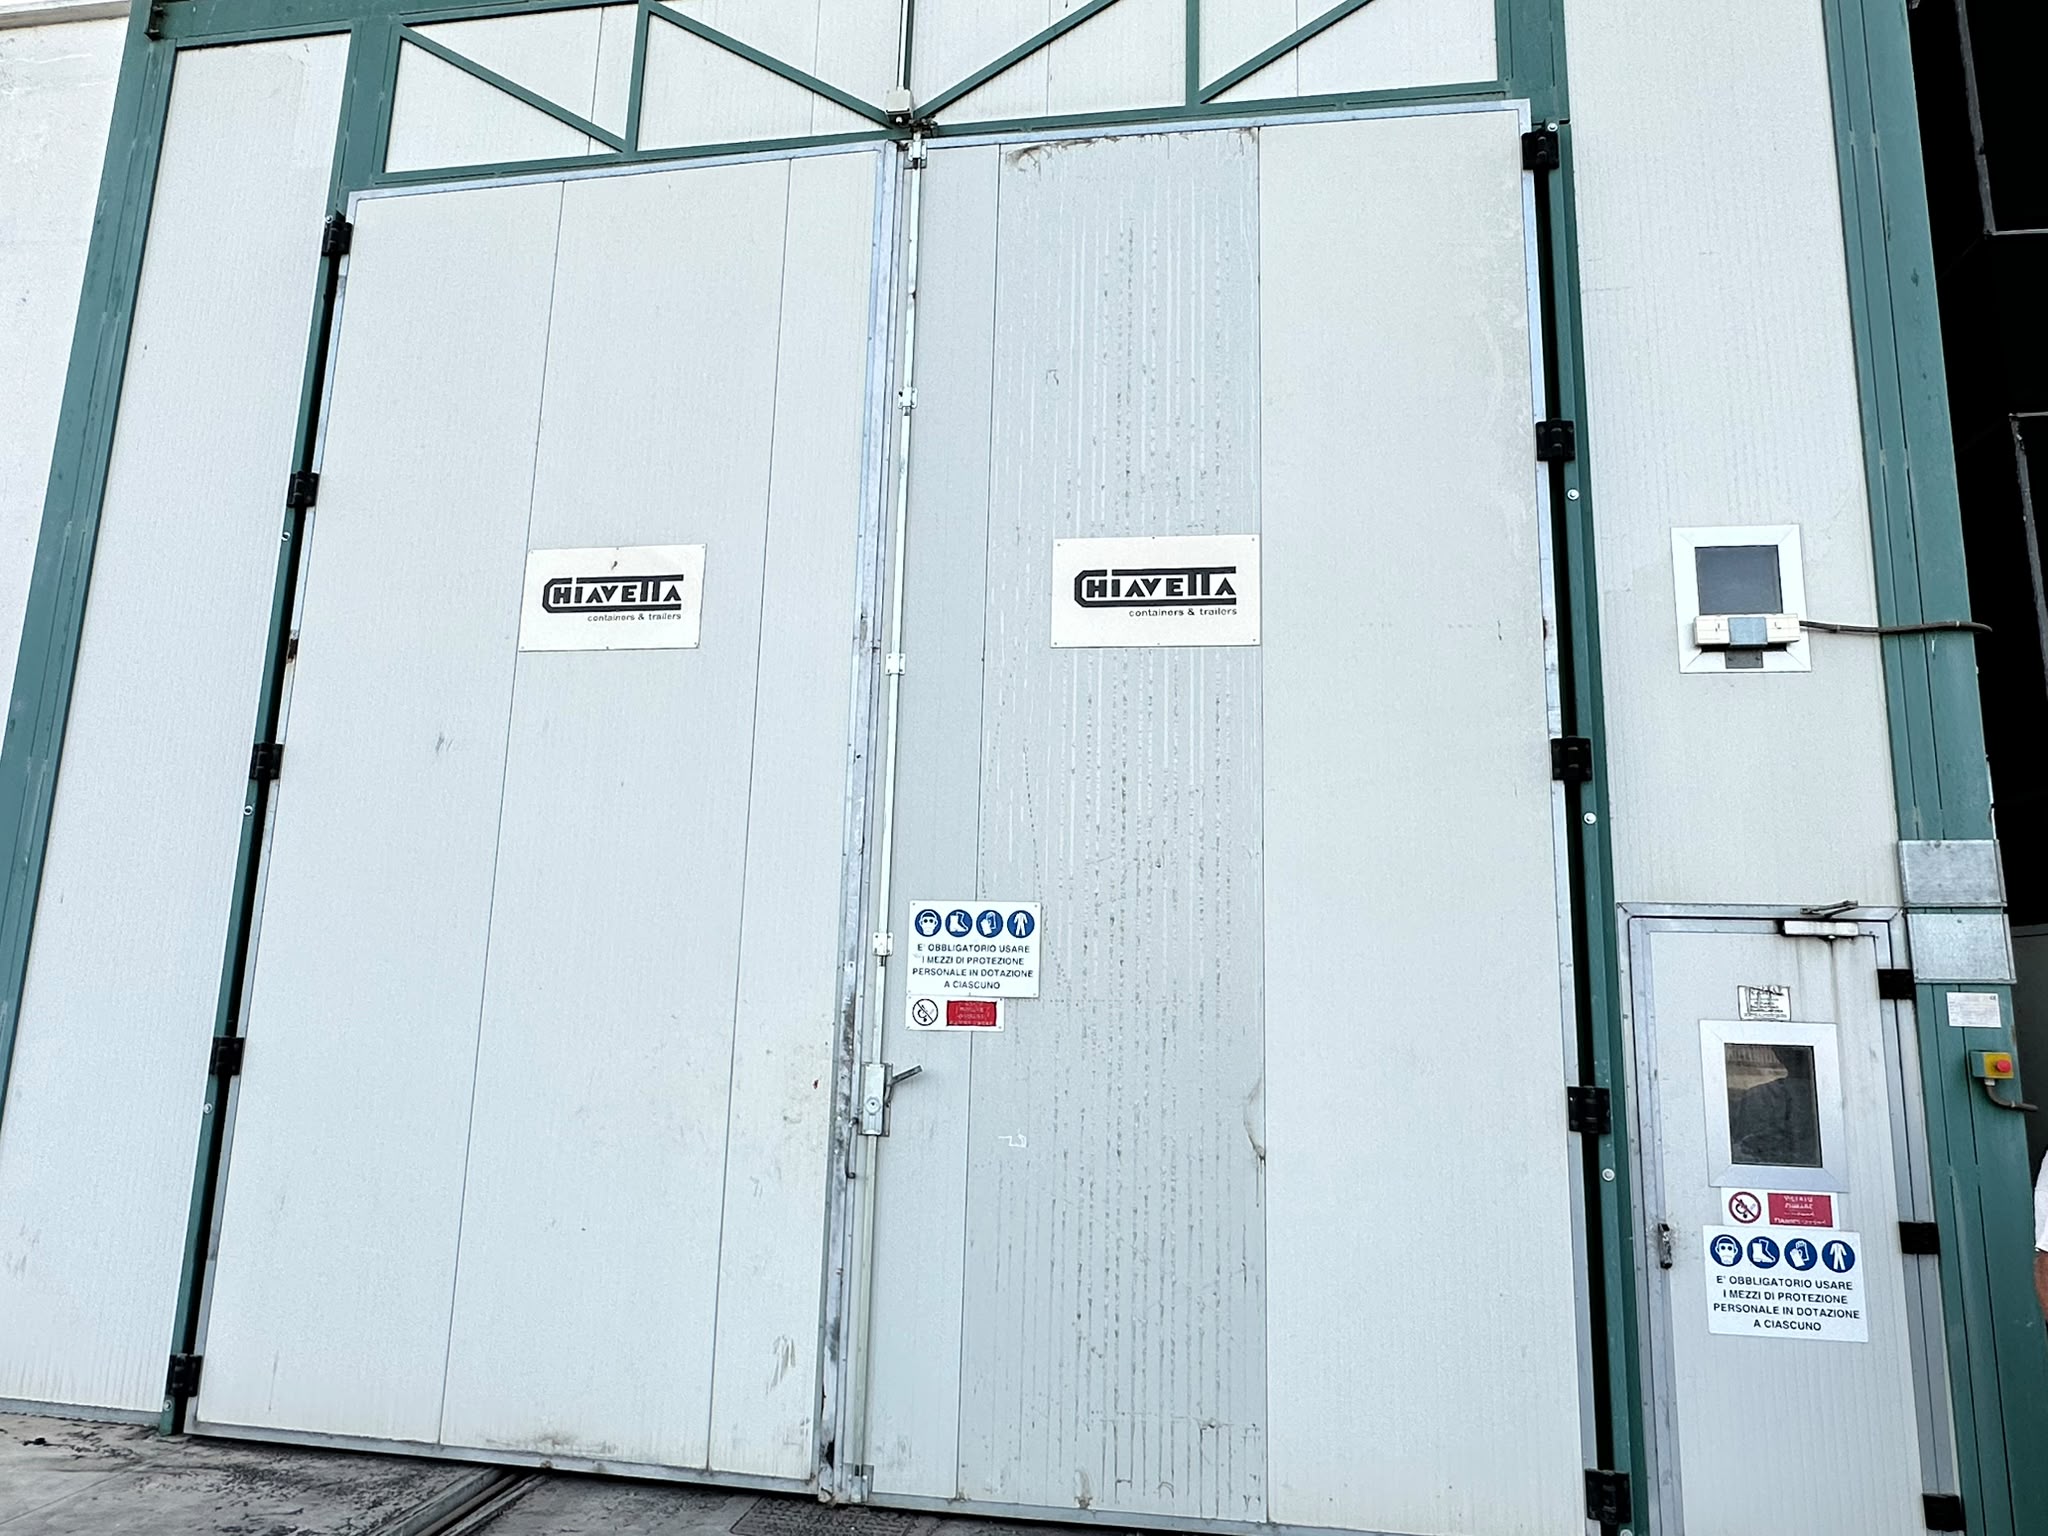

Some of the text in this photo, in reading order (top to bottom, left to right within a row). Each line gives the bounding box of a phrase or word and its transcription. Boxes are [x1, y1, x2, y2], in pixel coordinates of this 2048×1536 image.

[1074, 566, 1237, 608] CHIAVETTA
[542, 574, 684, 613] CHIAVETTA
[588, 612, 682, 622] containers & trailers
[1129, 607, 1237, 617] containers & trailers
[928, 944, 997, 953] OBBLIGATORIO
[999, 944, 1031, 953] USARE
[926, 956, 954, 964] MEZZI
[955, 956, 965, 964] DI
[967, 957, 1025, 966] PROTEZIONE
[912, 968, 1034, 978] PERSONALE IN DOTAZIONE
[943, 980, 1001, 990] A CIASCUNO
[1729, 1276, 1812, 1289] OBBLIGATORIO
[1815, 1279, 1853, 1291] USARE
[1729, 1289, 1761, 1300] MEZZI
[1764, 1291, 1775, 1301] DI
[1778, 1291, 1848, 1305] PROTEZIONE
[1713, 1303, 1860, 1319] PERSONALE IN DOTAZIONE
[1753, 1319, 1822, 1332] A CIASCUNO
